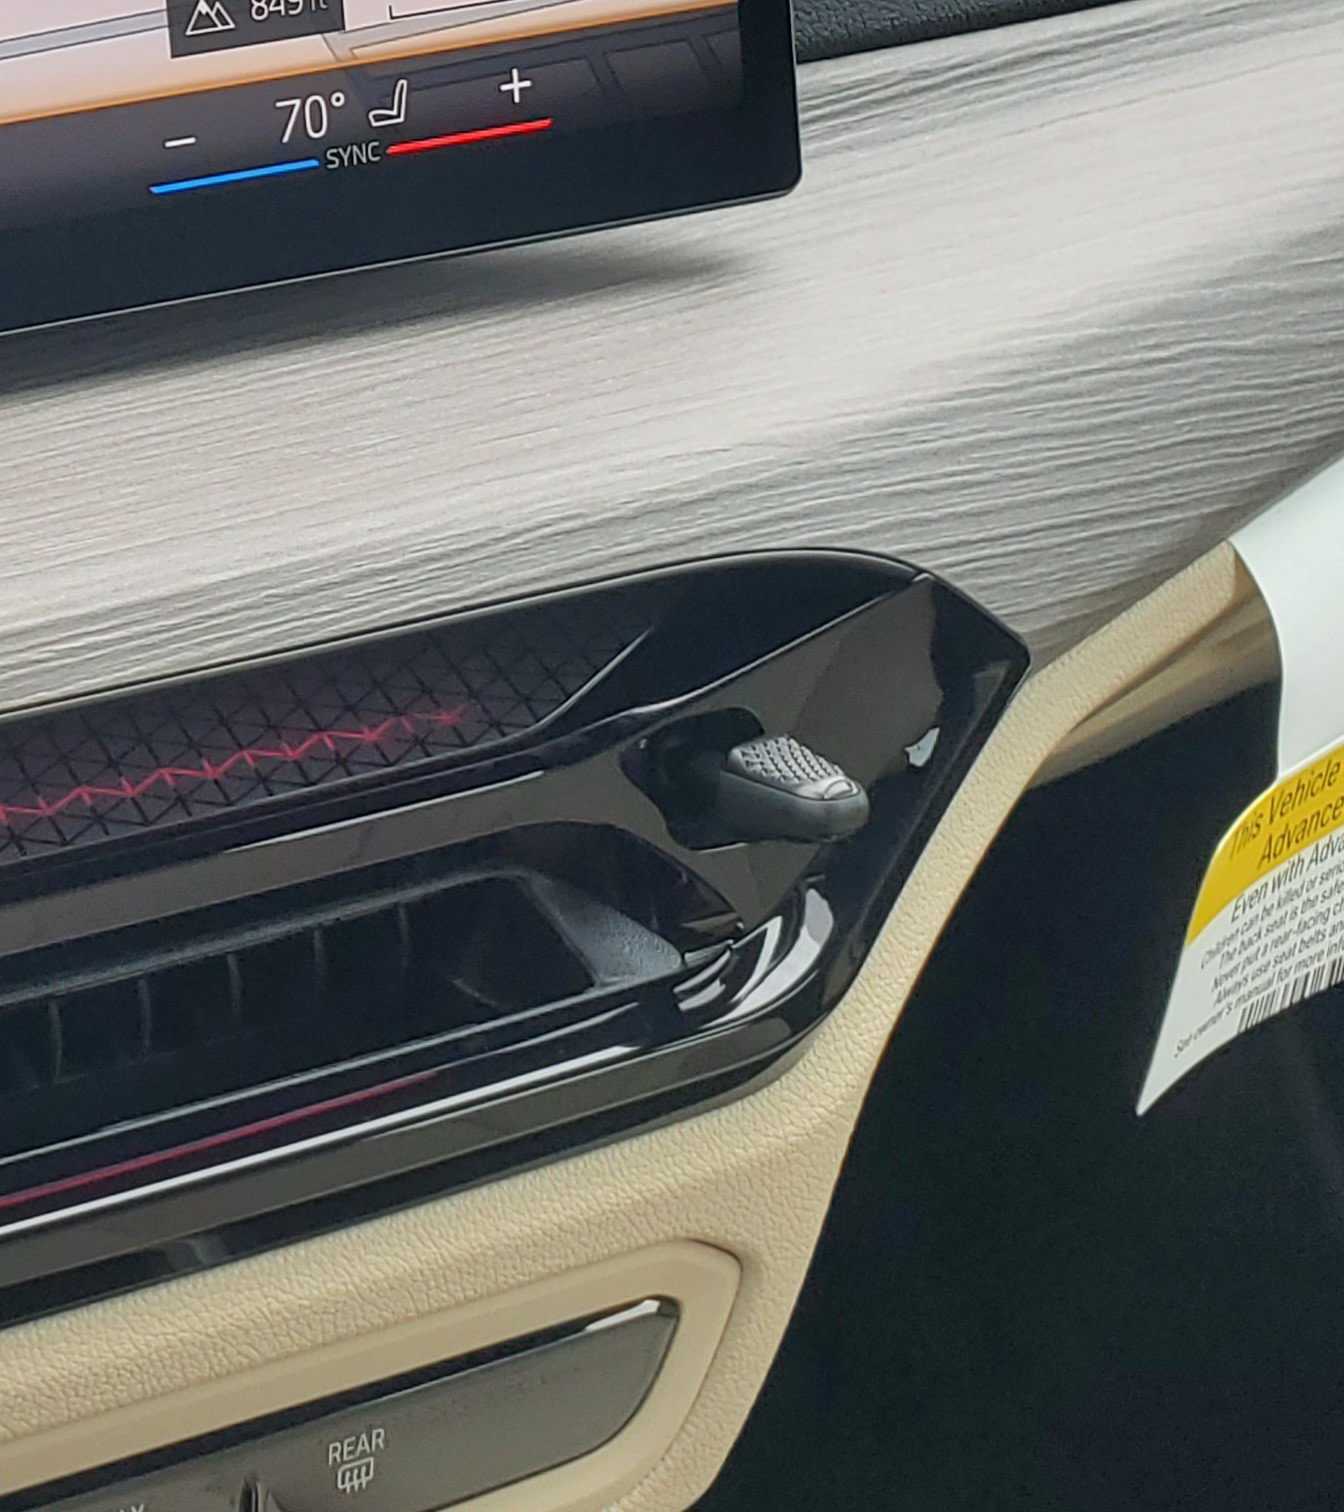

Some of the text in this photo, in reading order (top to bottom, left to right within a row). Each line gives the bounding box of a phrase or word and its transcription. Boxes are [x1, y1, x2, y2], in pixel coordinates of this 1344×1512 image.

[274, 91, 347, 144] 70°
[324, 141, 382, 169] SYNC
[1269, 759, 1341, 825] Vehicle
[1231, 882, 1268, 923] Even
[1271, 853, 1305, 893] with
[328, 1428, 385, 1466] REAR
